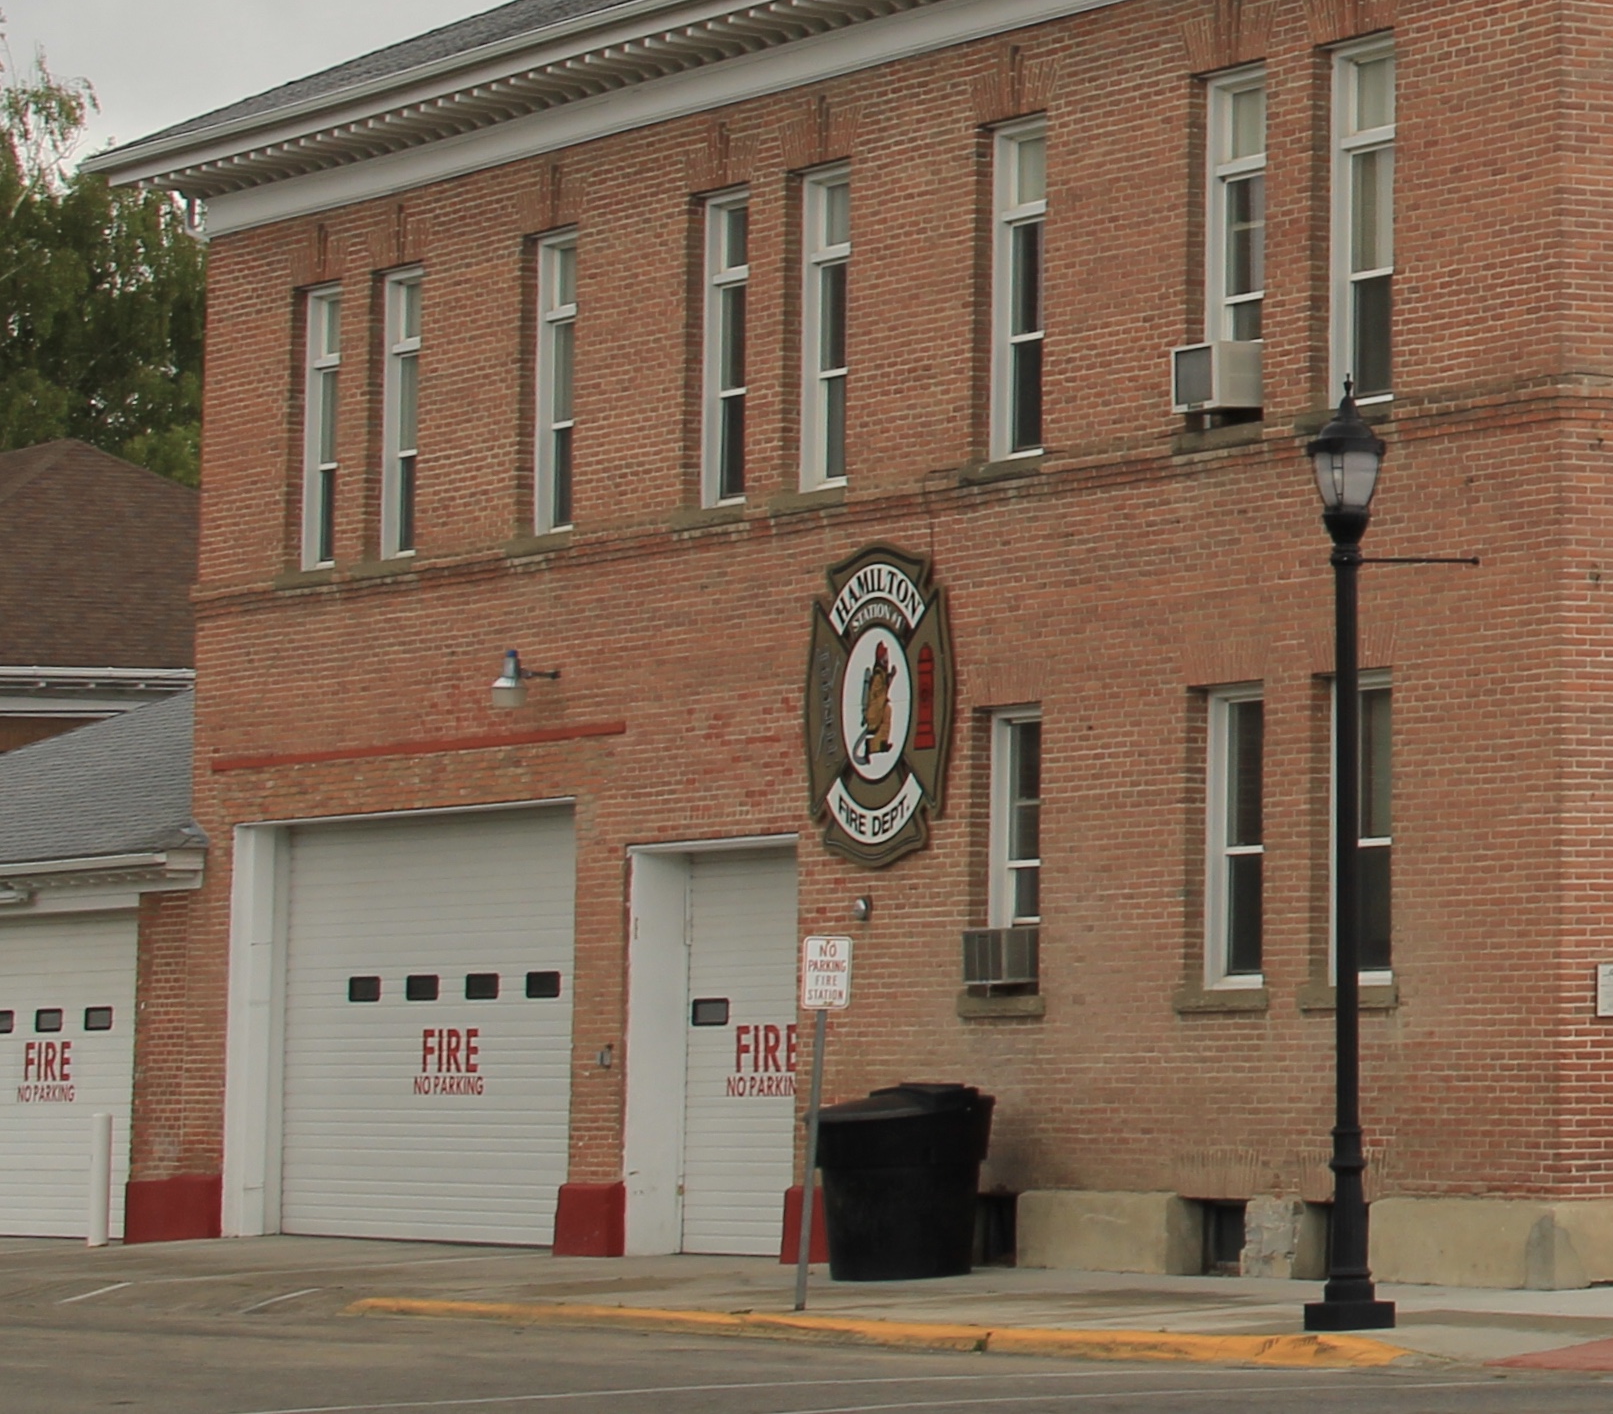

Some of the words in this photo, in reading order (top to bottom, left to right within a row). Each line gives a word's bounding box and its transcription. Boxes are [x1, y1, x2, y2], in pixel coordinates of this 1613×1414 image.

[835, 568, 921, 626] HAMILTON
[852, 603, 890, 632] STATION
[838, 794, 867, 835] FIRE
[872, 794, 910, 837] DEPT.
[819, 944, 837, 958] NO
[807, 959, 847, 973] PARKING
[815, 975, 838, 987] FIRE
[807, 989, 844, 1001] STATION
[422, 1028, 480, 1073] FIRE
[736, 1024, 797, 1073] FIRE
[24, 1041, 72, 1082] FIRE
[17, 1084, 32, 1103] NO
[33, 1084, 75, 1103] PARKING
[413, 1075, 431, 1096] NO
[433, 1075, 484, 1096] PARKING
[726, 1075, 746, 1097] NO
[748, 1075, 797, 1097] PARKIN
